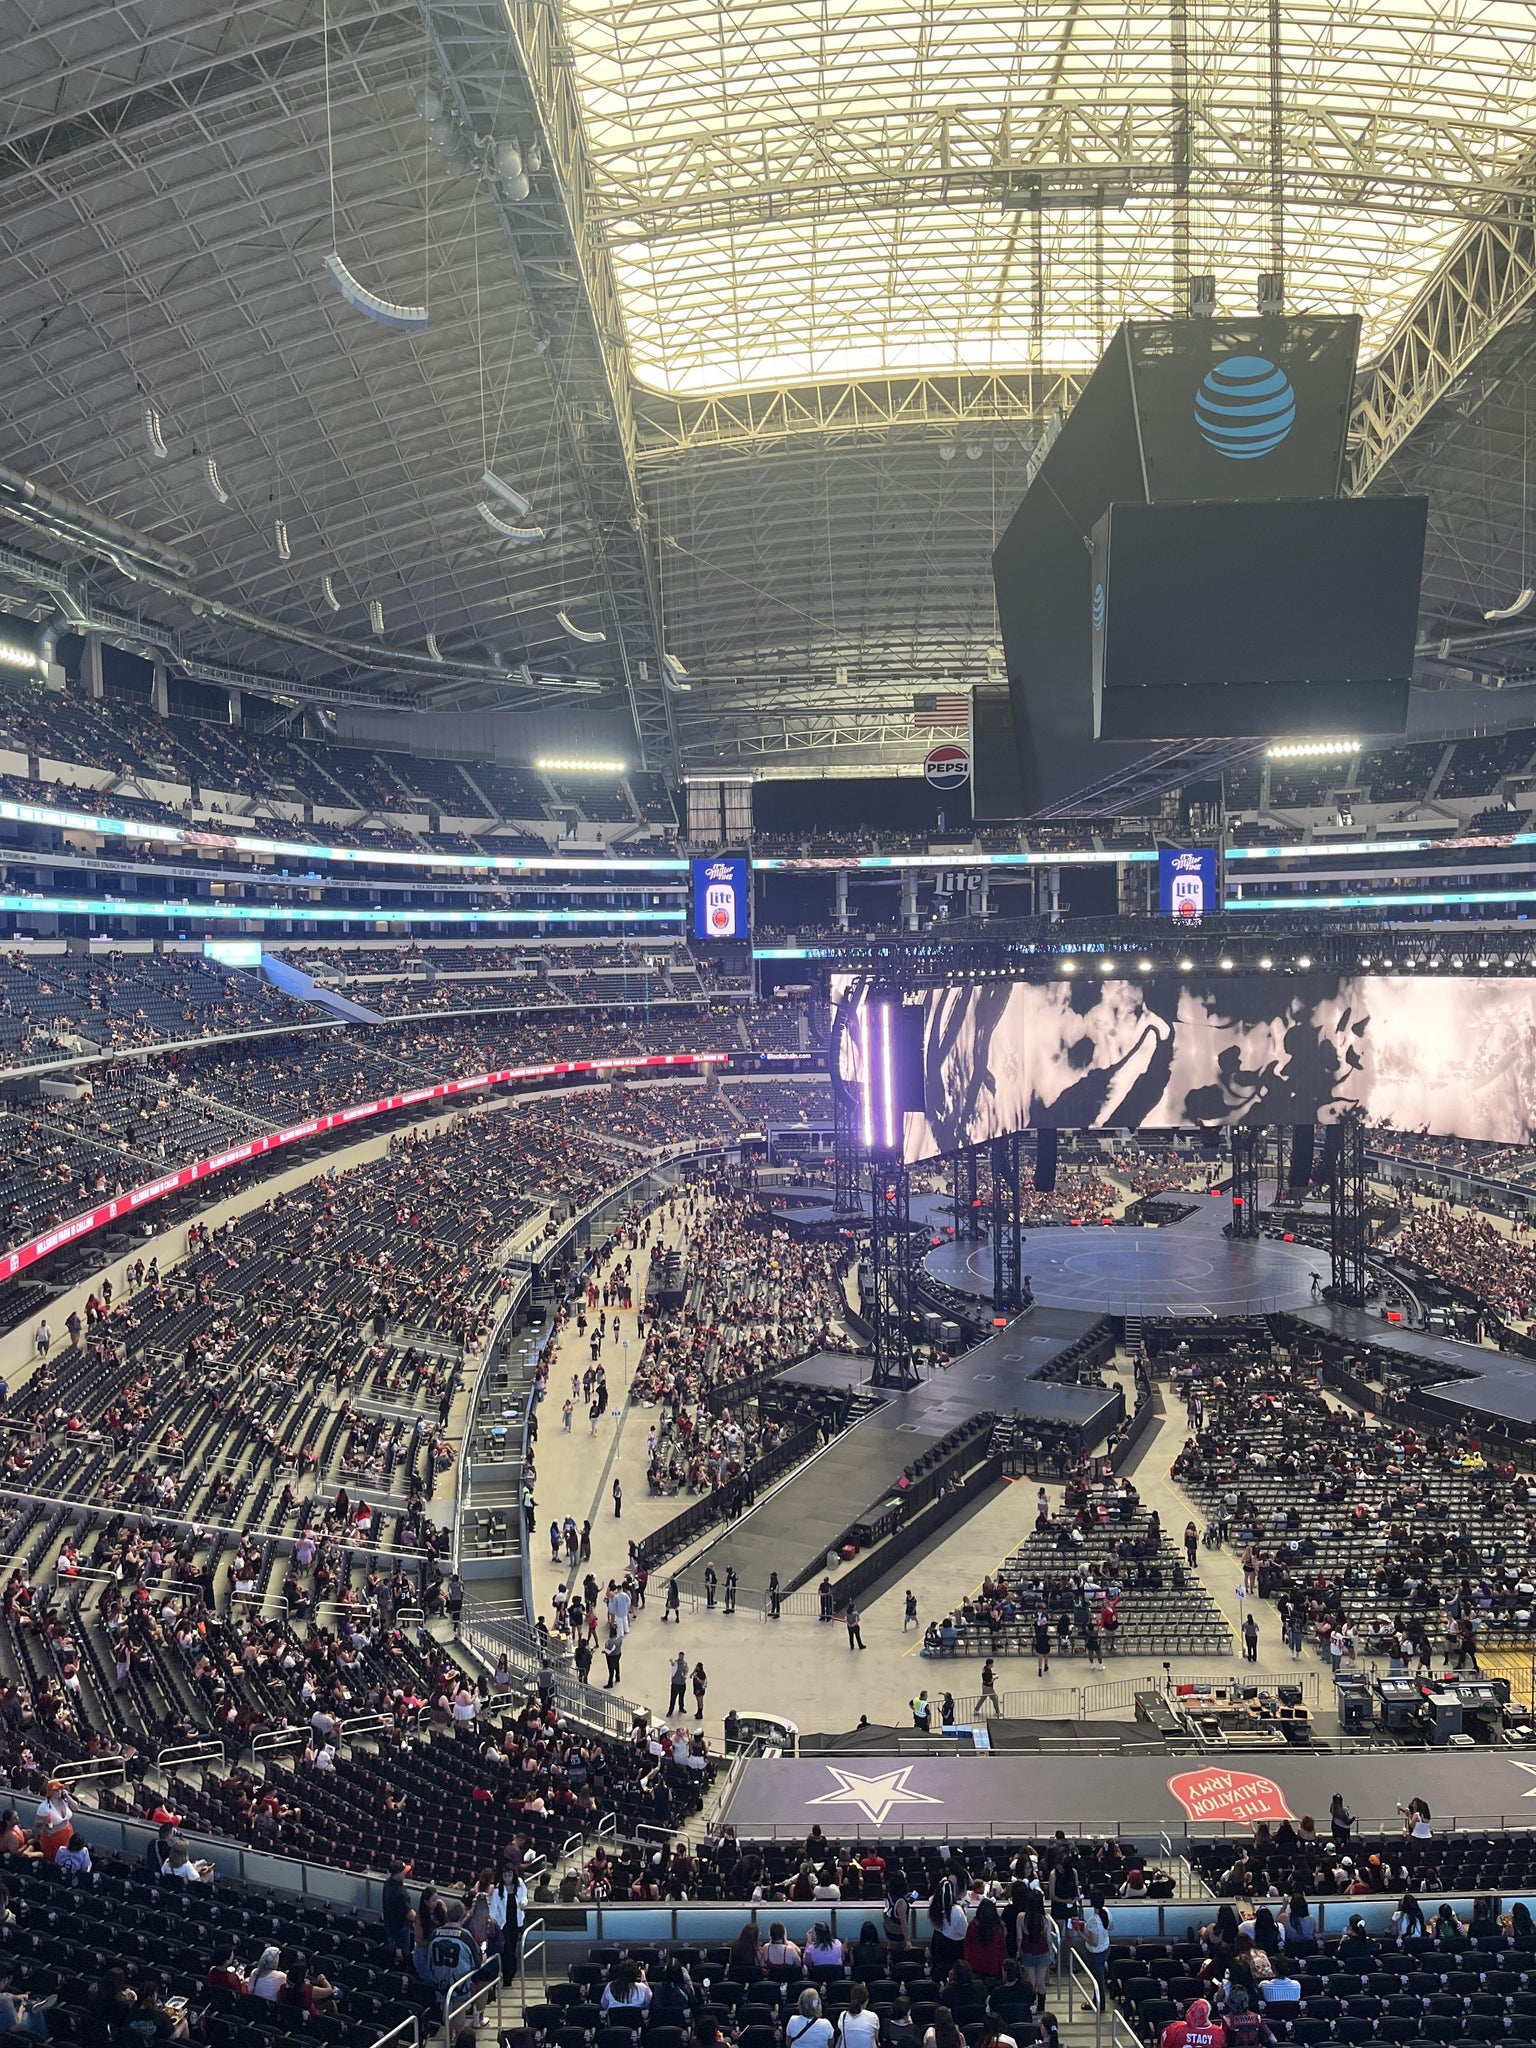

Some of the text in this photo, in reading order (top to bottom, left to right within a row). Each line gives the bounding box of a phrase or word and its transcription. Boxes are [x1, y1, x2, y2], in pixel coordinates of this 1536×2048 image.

[927, 763, 968, 773] PEPSI
[933, 872, 982, 897] Lite
[1176, 882, 1200, 898] Lite
[709, 892, 732, 907] Lite
[1189, 1773, 1233, 1800] ARMY
[1191, 1780, 1273, 1817] SALVATION
[1232, 1799, 1271, 1819] THE
[1186, 2033, 1213, 2045] STACY
